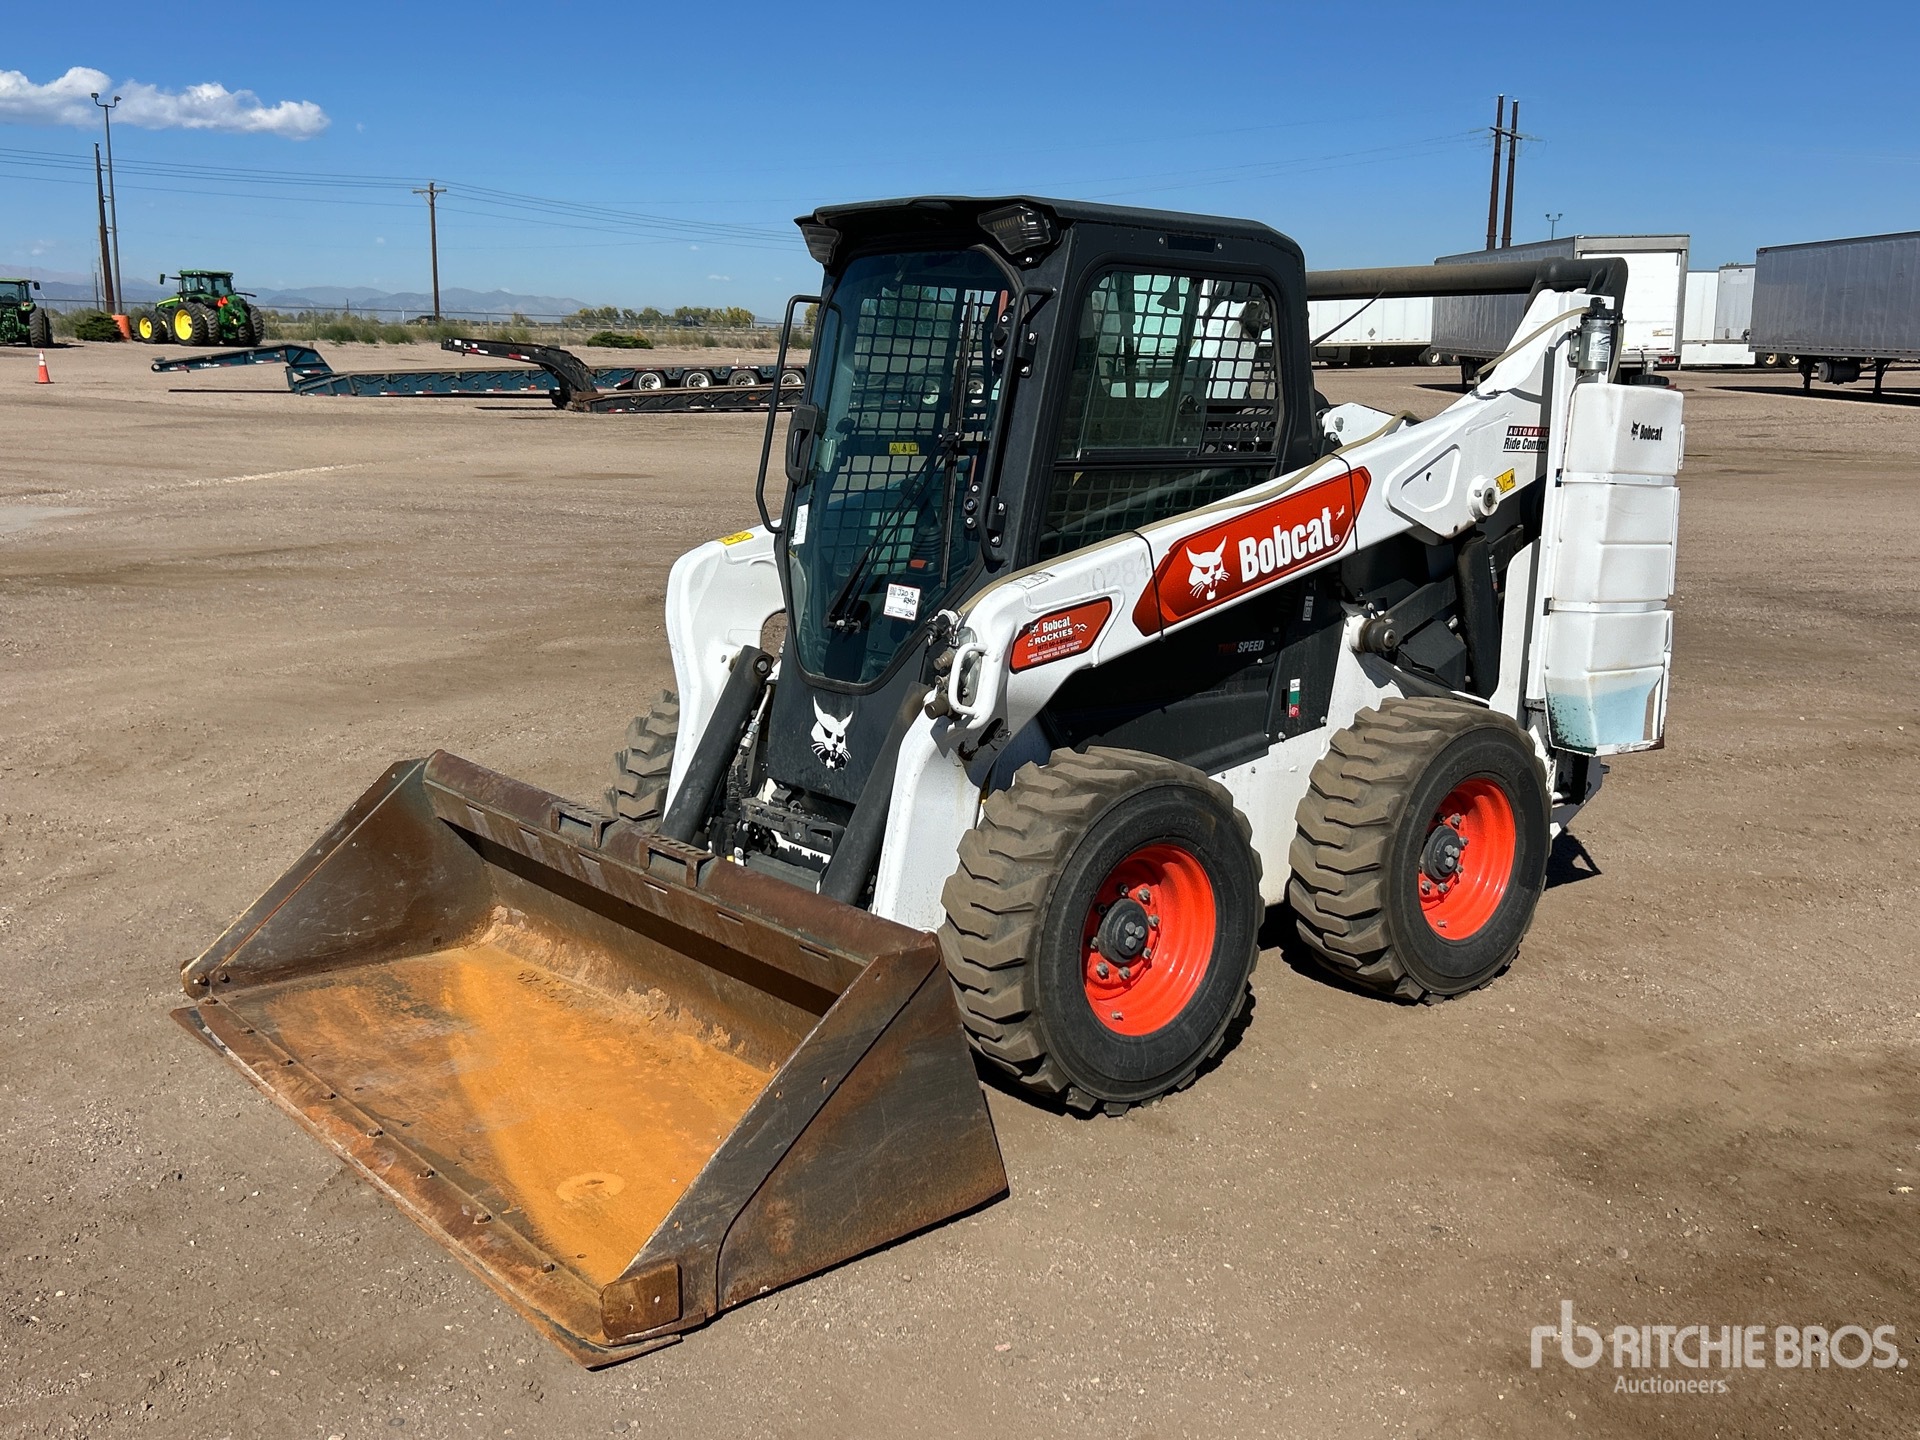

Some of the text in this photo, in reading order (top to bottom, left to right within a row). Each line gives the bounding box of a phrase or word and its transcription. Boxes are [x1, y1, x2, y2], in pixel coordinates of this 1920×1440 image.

[1639, 424, 1663, 441] Bobcat
[1503, 437, 1521, 450] Ride
[1238, 506, 1334, 583] Bobcat
[1042, 616, 1070, 633] Bobcat
[1034, 628, 1073, 644] ROCKIES
[1237, 640, 1265, 654] SPEED
